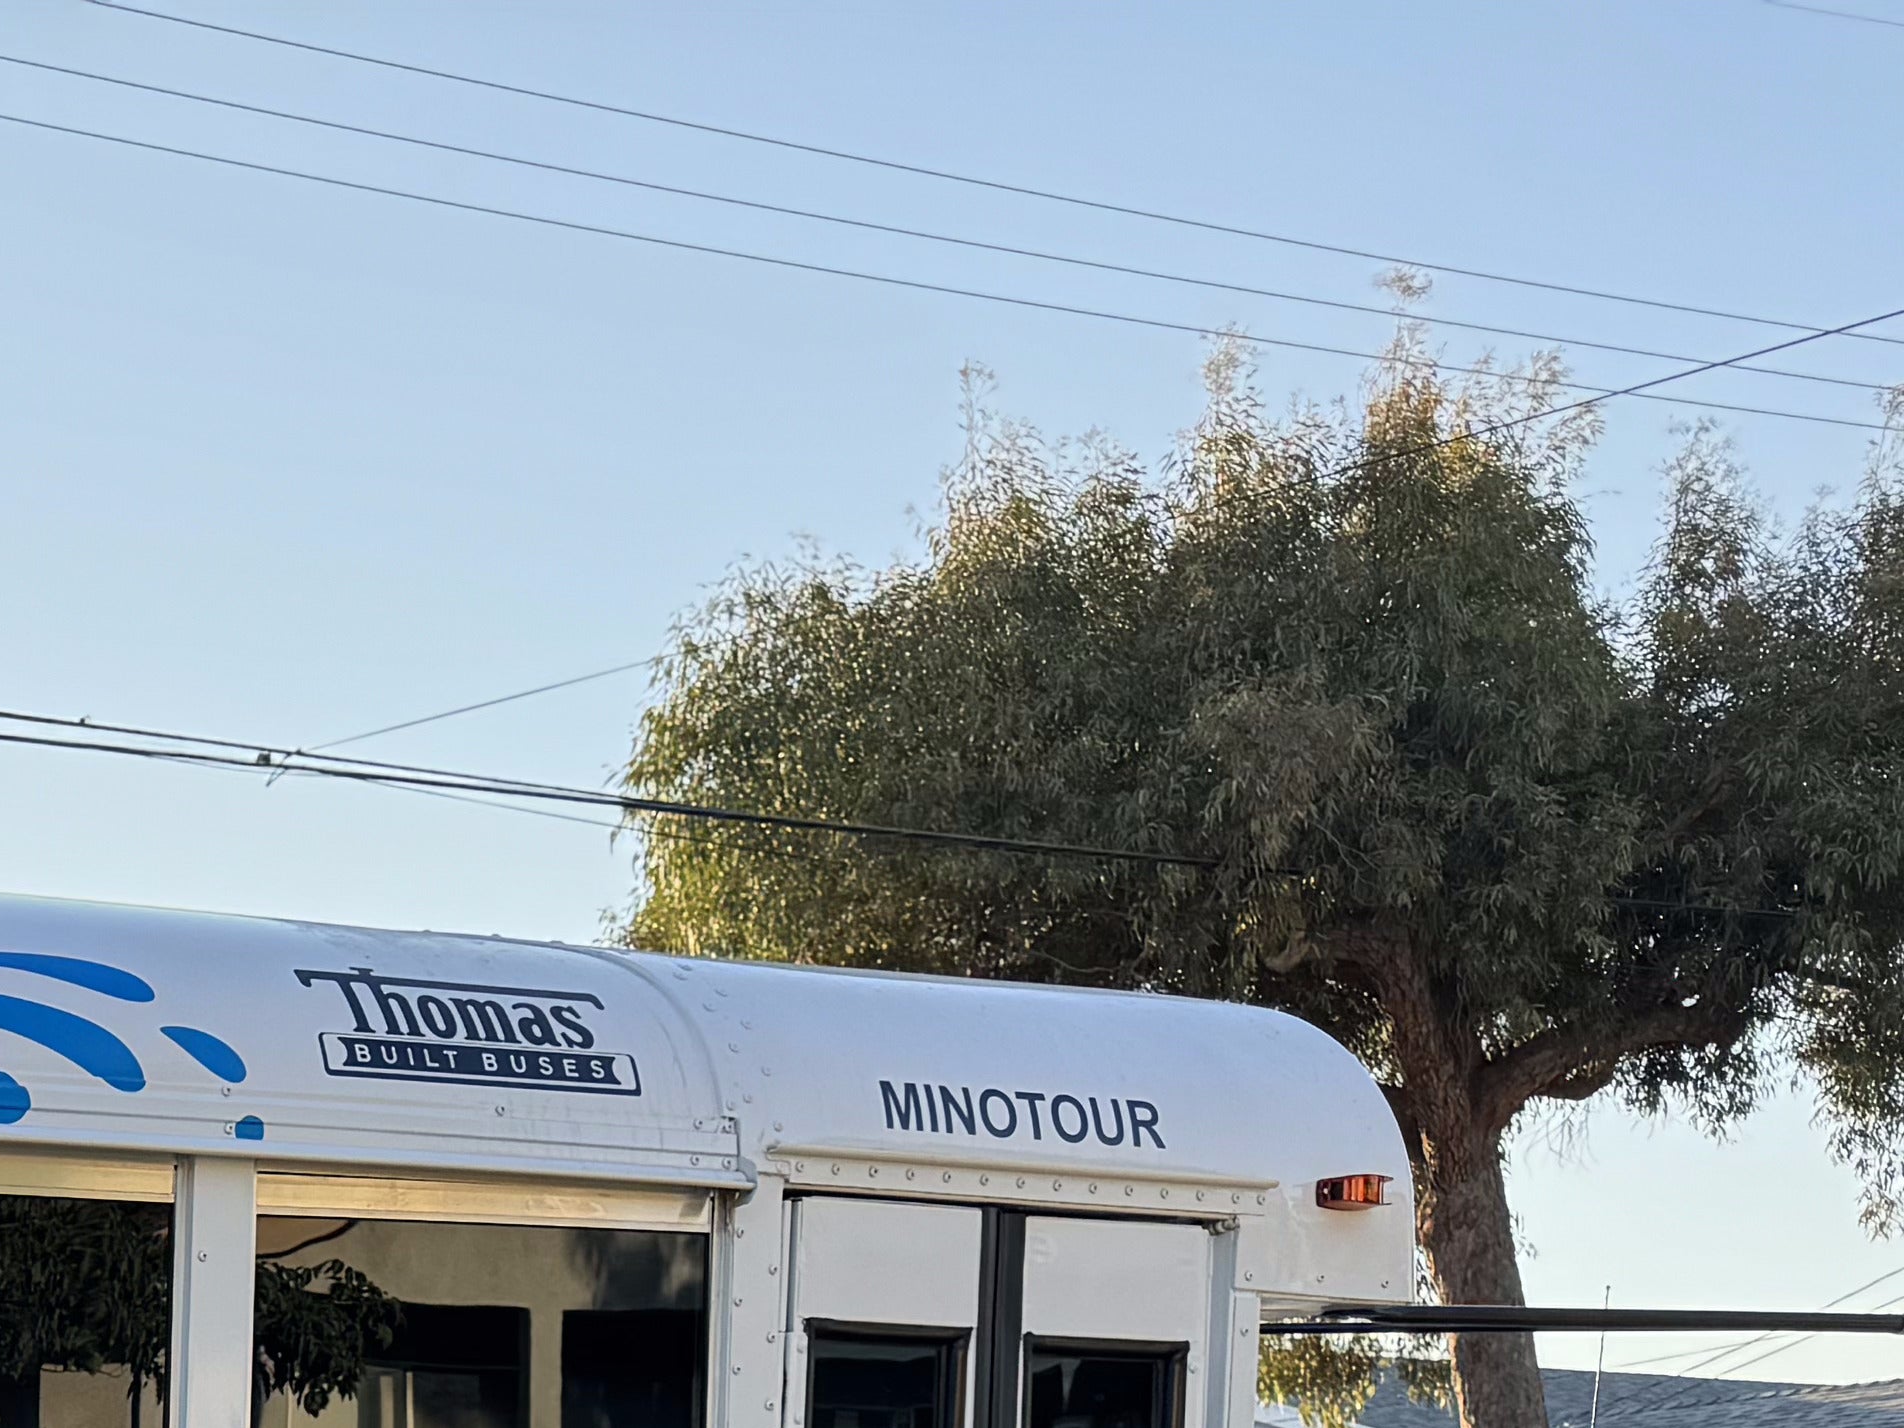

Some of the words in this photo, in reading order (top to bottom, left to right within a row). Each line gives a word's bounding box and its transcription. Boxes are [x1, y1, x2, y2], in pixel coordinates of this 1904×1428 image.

[293, 967, 605, 1050] Thomas
[354, 1043, 459, 1070] BUILT
[481, 1052, 606, 1080] BUSES
[879, 1080, 1167, 1149] MINOTOUR
